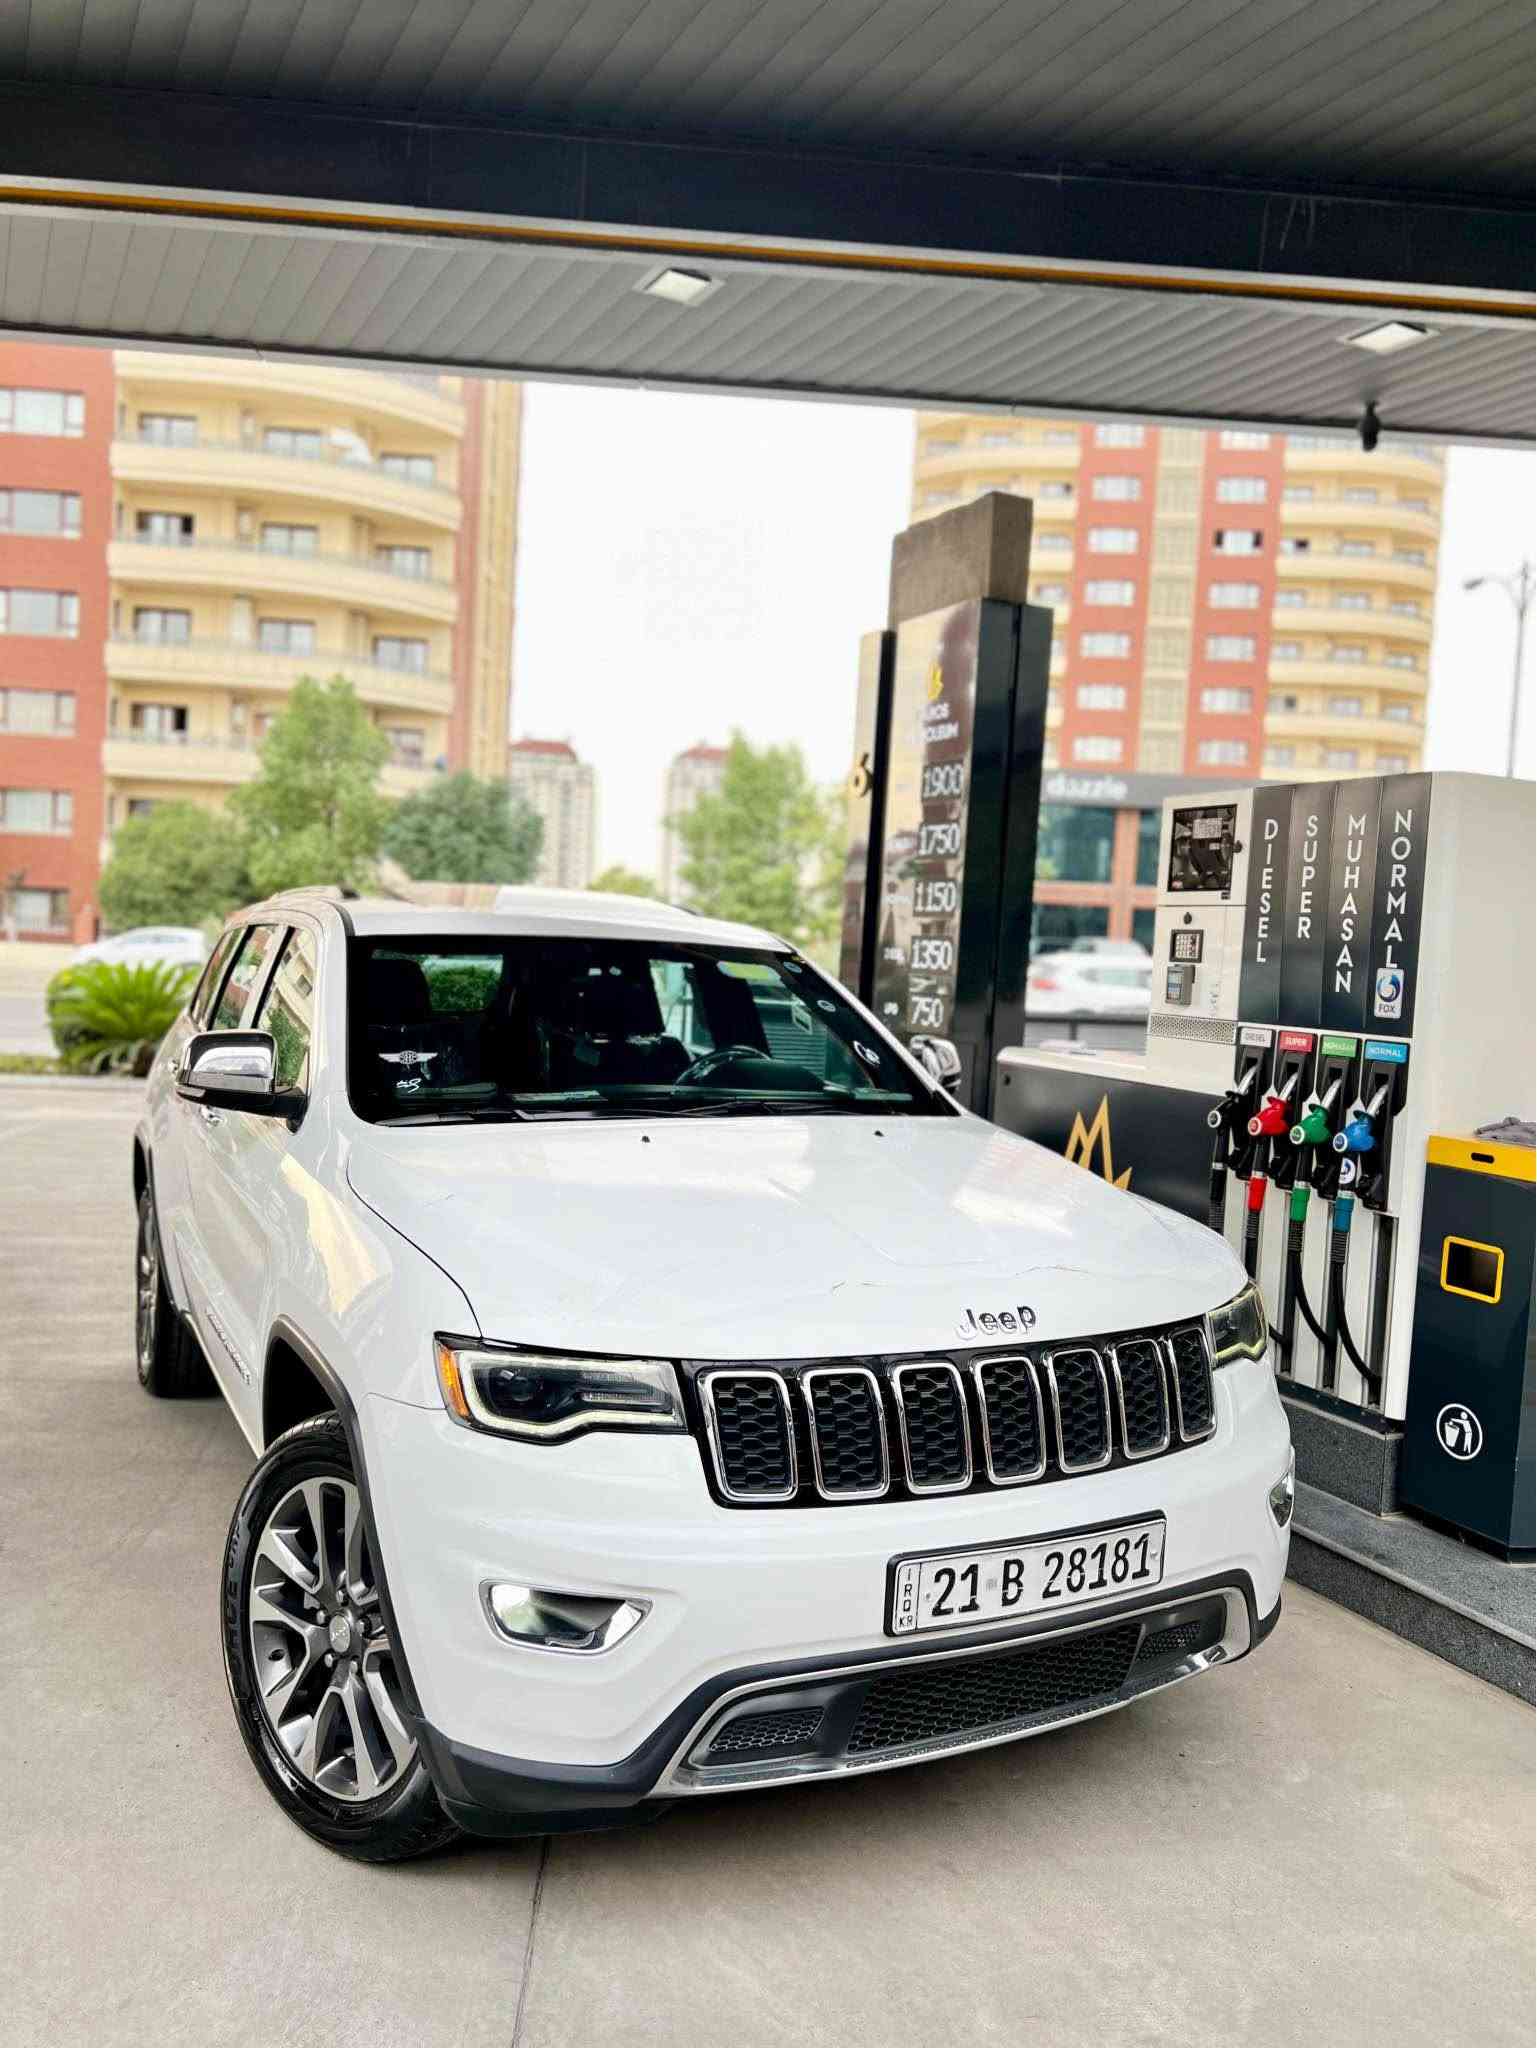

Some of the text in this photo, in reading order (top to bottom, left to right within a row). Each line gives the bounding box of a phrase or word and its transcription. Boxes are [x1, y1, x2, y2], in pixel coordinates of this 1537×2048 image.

[923, 763, 963, 798] 1900
[918, 822, 960, 855] 1750
[1256, 818, 1279, 963] DIESEL
[1297, 815, 1319, 939] SUPER
[1384, 809, 1413, 969] NORMAL
[914, 880, 957, 912] 1150
[1335, 814, 1366, 993] MUHASAN
[911, 939, 953, 971] 1350
[910, 995, 945, 1028] 750
[1378, 1004, 1396, 1013] FOX
[1285, 1036, 1308, 1047] SUPER
[1370, 1045, 1402, 1057] NORMAL
[954, 1305, 1036, 1341] Jeep
[931, 1533, 1150, 1616] 21 B 28181
